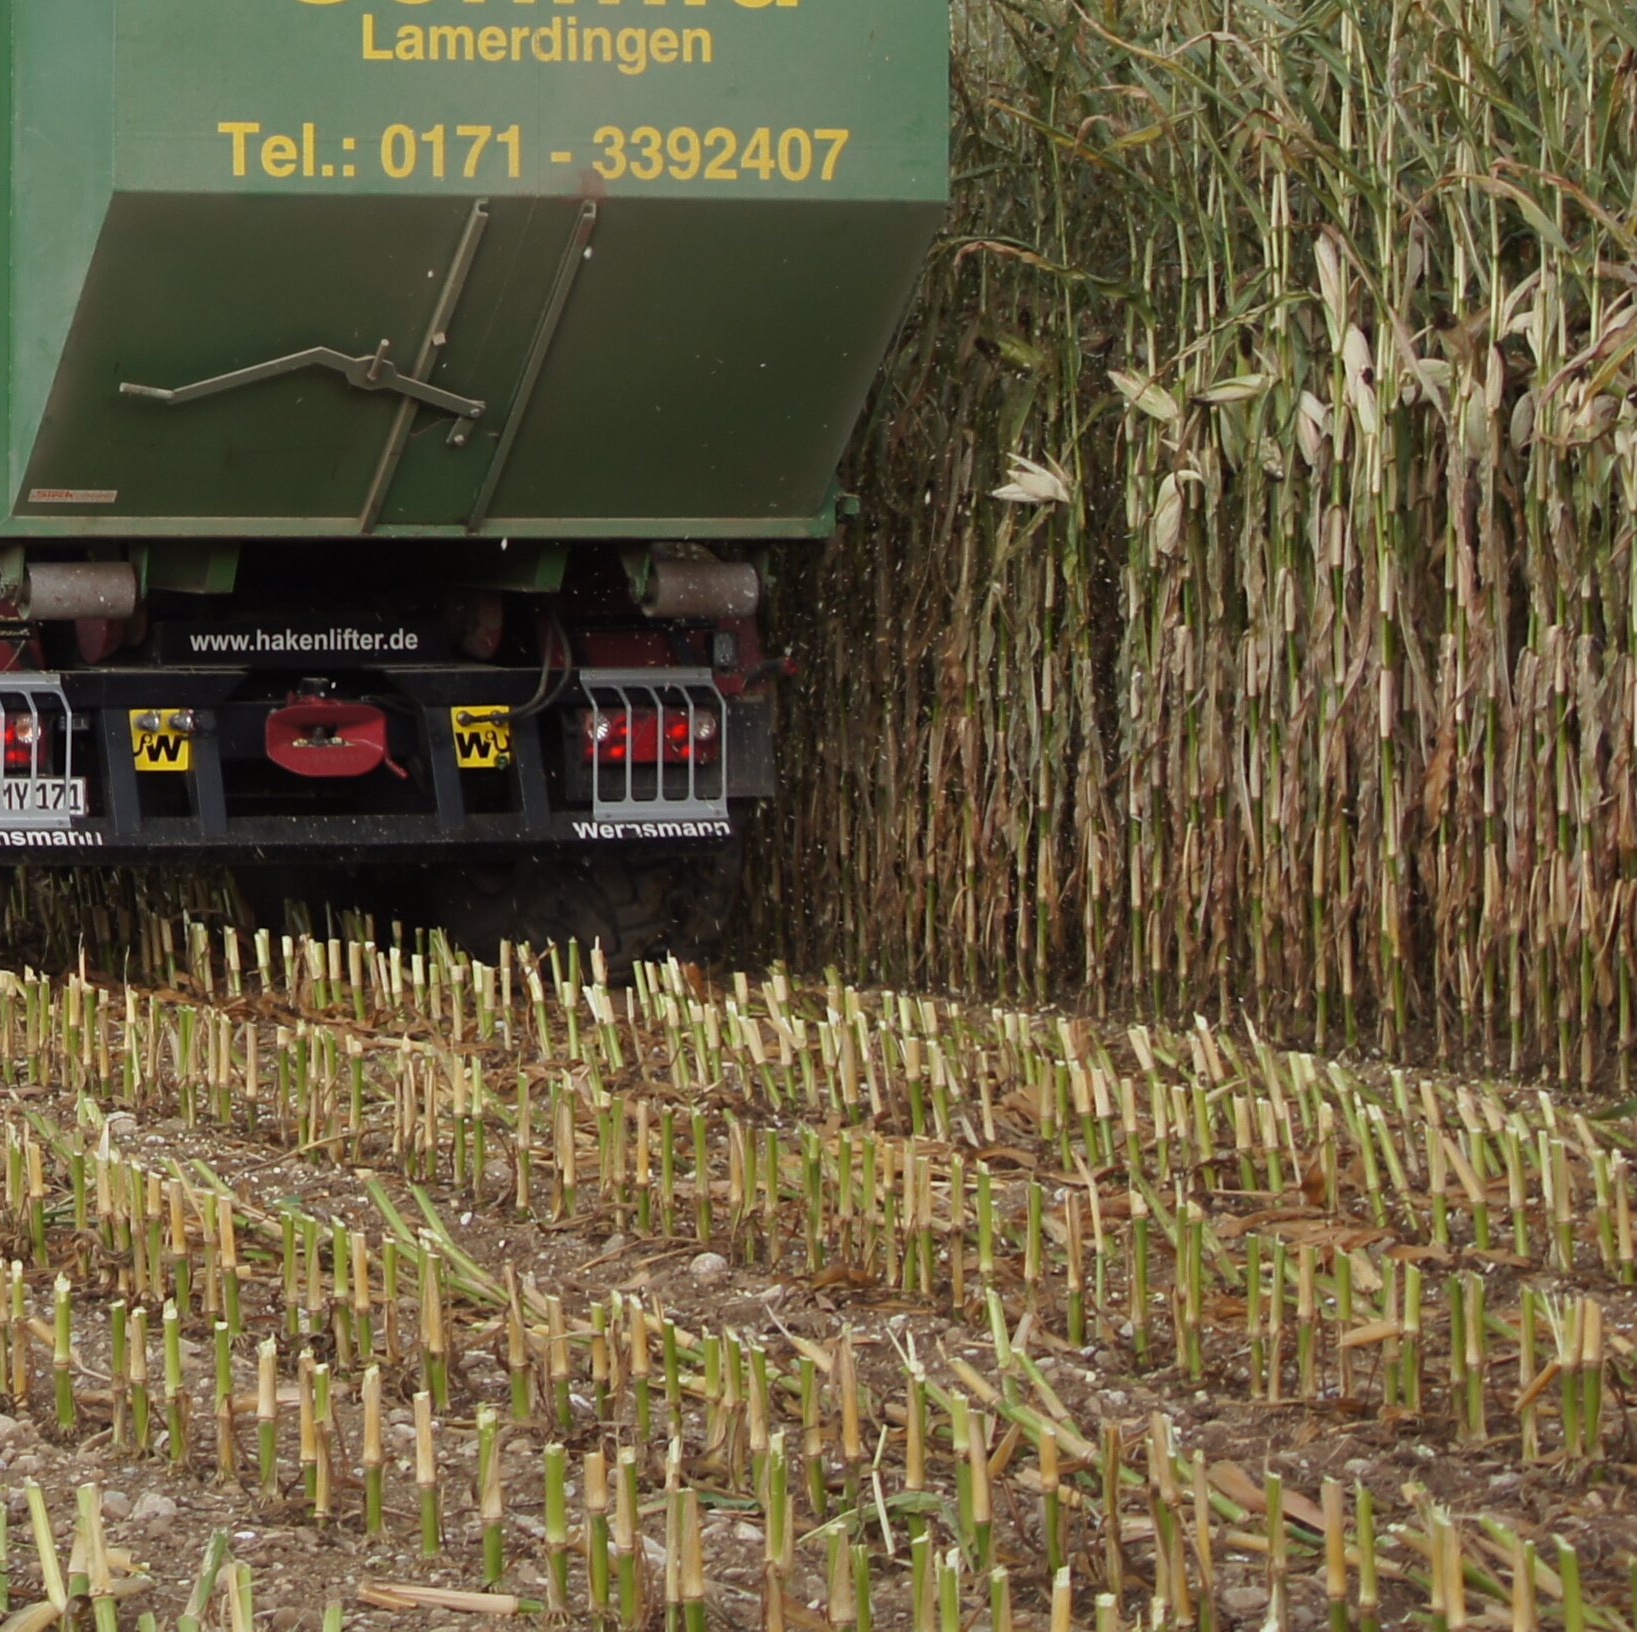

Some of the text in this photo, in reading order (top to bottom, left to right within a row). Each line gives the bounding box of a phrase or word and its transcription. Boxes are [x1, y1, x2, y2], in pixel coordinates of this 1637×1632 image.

[361, 13, 713, 76] Lamerdingen
[217, 121, 357, 179] Tel.:
[380, 123, 522, 180] 0171
[591, 125, 850, 183] 3392407
[189, 627, 419, 652] www.hakenlifter.de
[36, 782, 82, 811] 171
